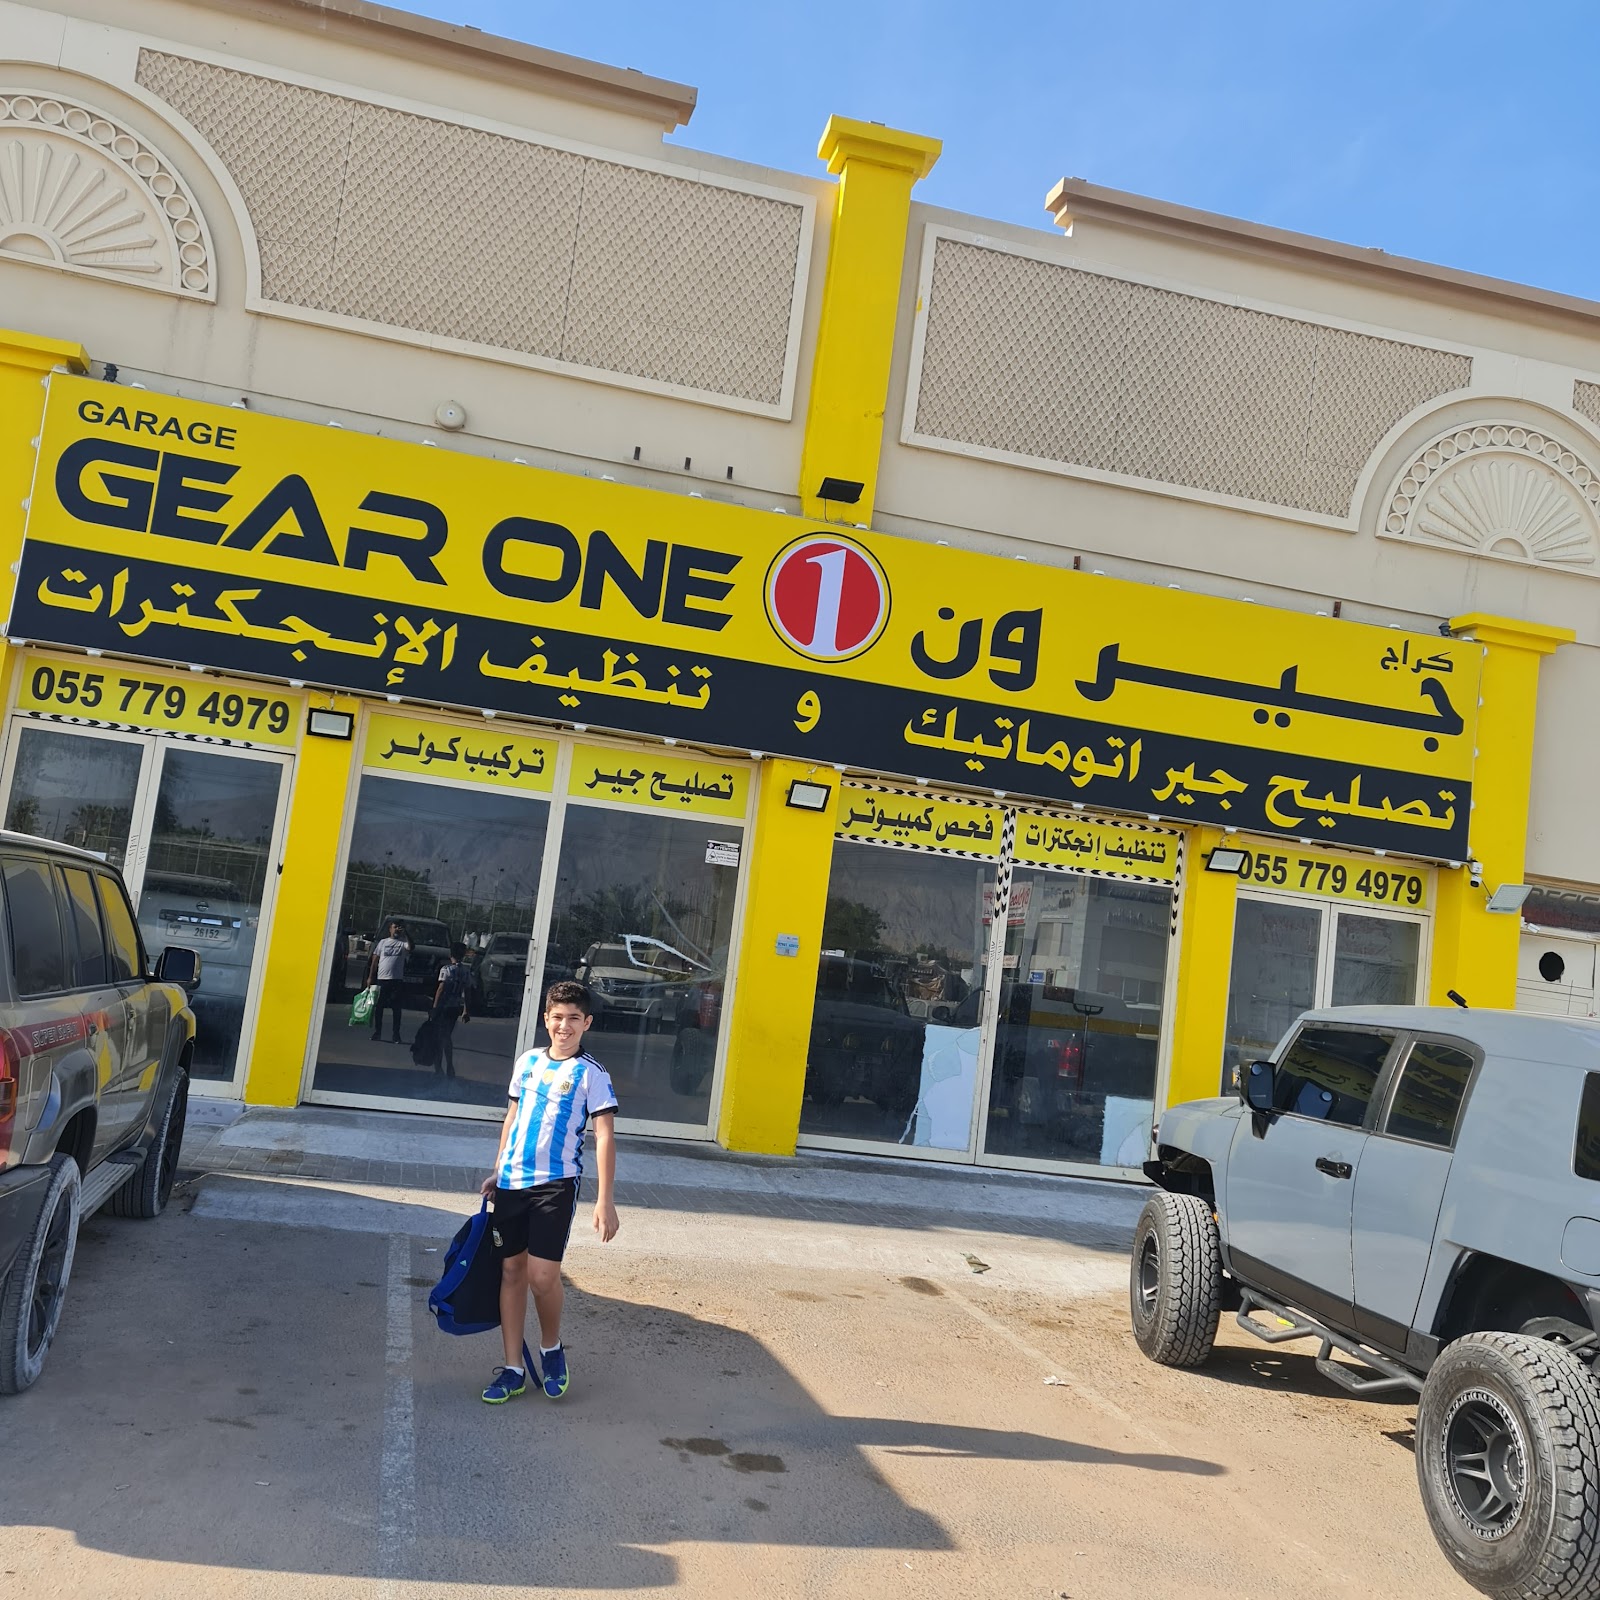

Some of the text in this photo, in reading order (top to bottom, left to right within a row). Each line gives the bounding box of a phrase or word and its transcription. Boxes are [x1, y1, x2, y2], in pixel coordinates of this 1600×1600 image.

[78, 400, 237, 451] GARAGE
[56, 437, 744, 632] GEAR ONE
[805, 550, 861, 655] 1
[1380, 639, 1454, 674] كراج
[32, 666, 290, 734] 055 779 4979
[38, 568, 1455, 831] تصليح جير اتوماتيك و تنظيف الإنجكترات
[380, 732, 545, 778] تركيب كولر
[585, 766, 734, 804] تصليح جير
[842, 797, 994, 842] فحص كمبيوتر
[1025, 824, 1167, 867] تنظيف إنجكترات
[1238, 851, 1423, 905] 055 779 4979
[193, 927, 220, 939] 26152
